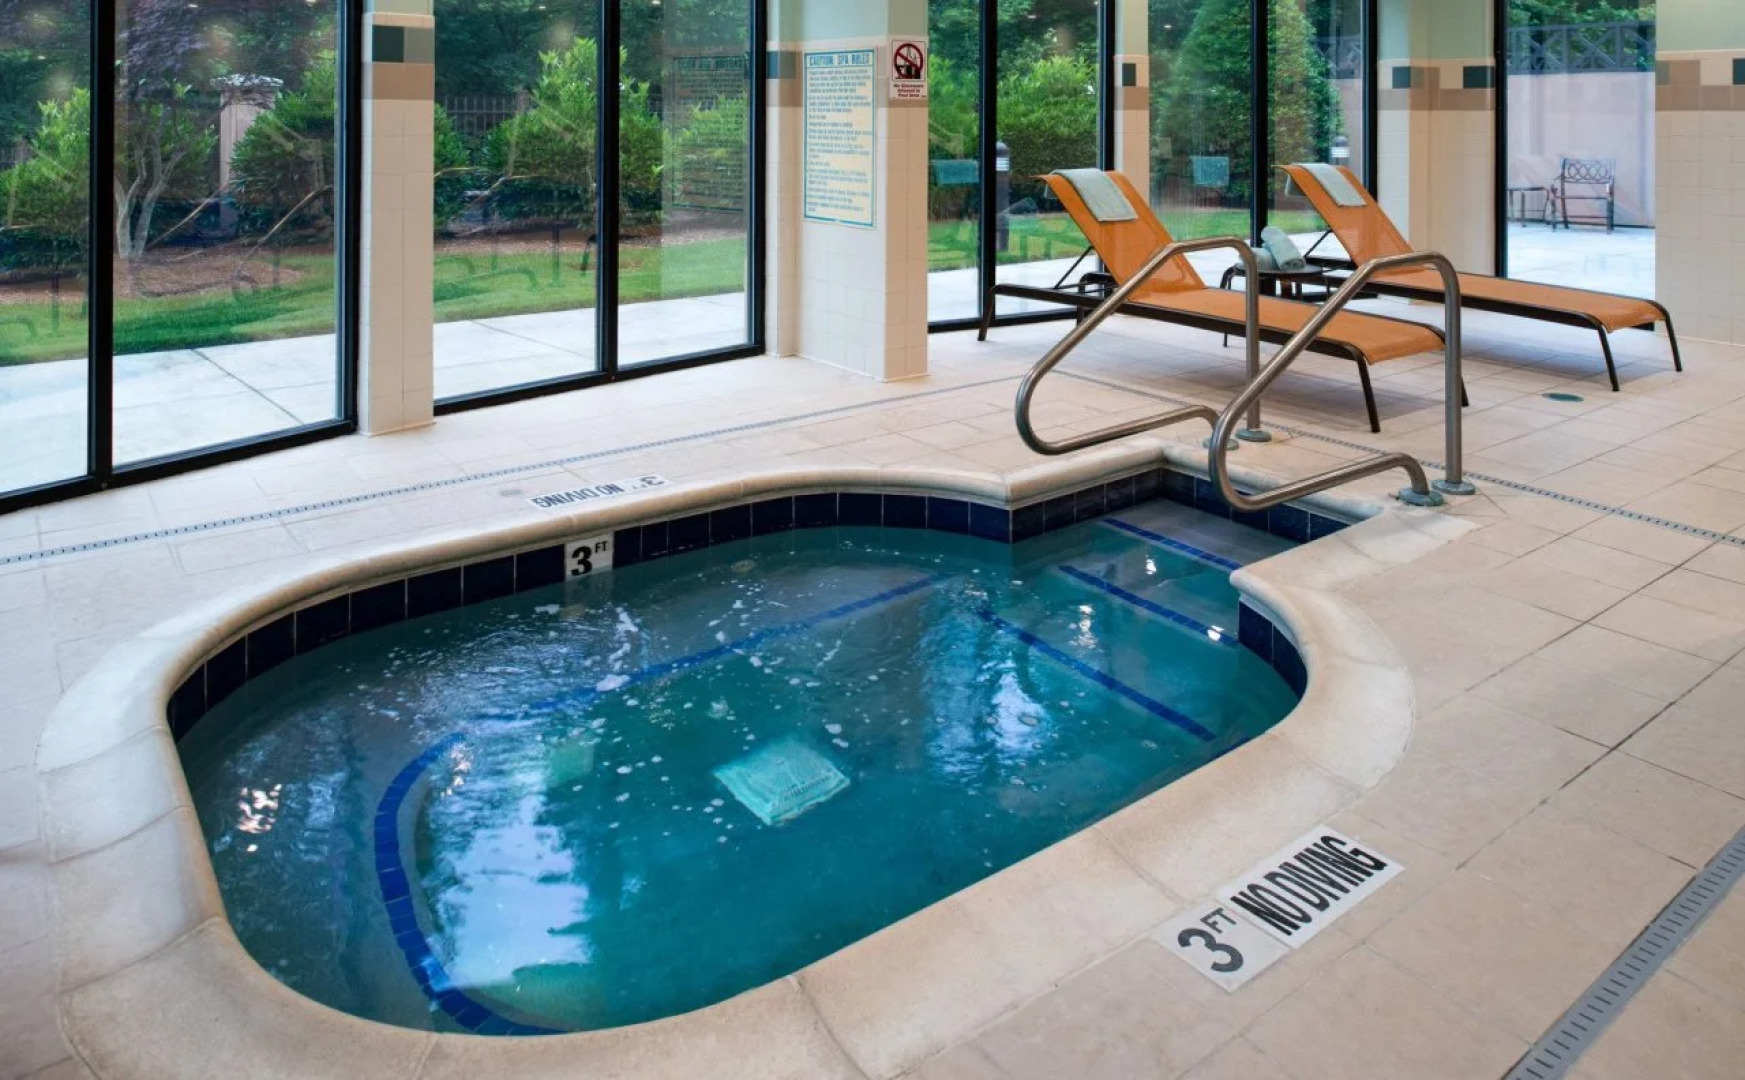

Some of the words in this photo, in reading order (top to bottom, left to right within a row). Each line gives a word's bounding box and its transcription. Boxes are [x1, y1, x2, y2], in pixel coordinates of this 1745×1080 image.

[836, 54, 849, 65] SPA
[851, 52, 870, 65] RULES
[531, 487, 600, 508] DIVING
[595, 483, 624, 496] NO
[571, 545, 592, 576] 3
[594, 540, 608, 554] FT
[1263, 835, 1388, 912] DIVING
[1199, 907, 1237, 934] FT
[1230, 883, 1313, 936] NO
[1177, 928, 1244, 973] 3
